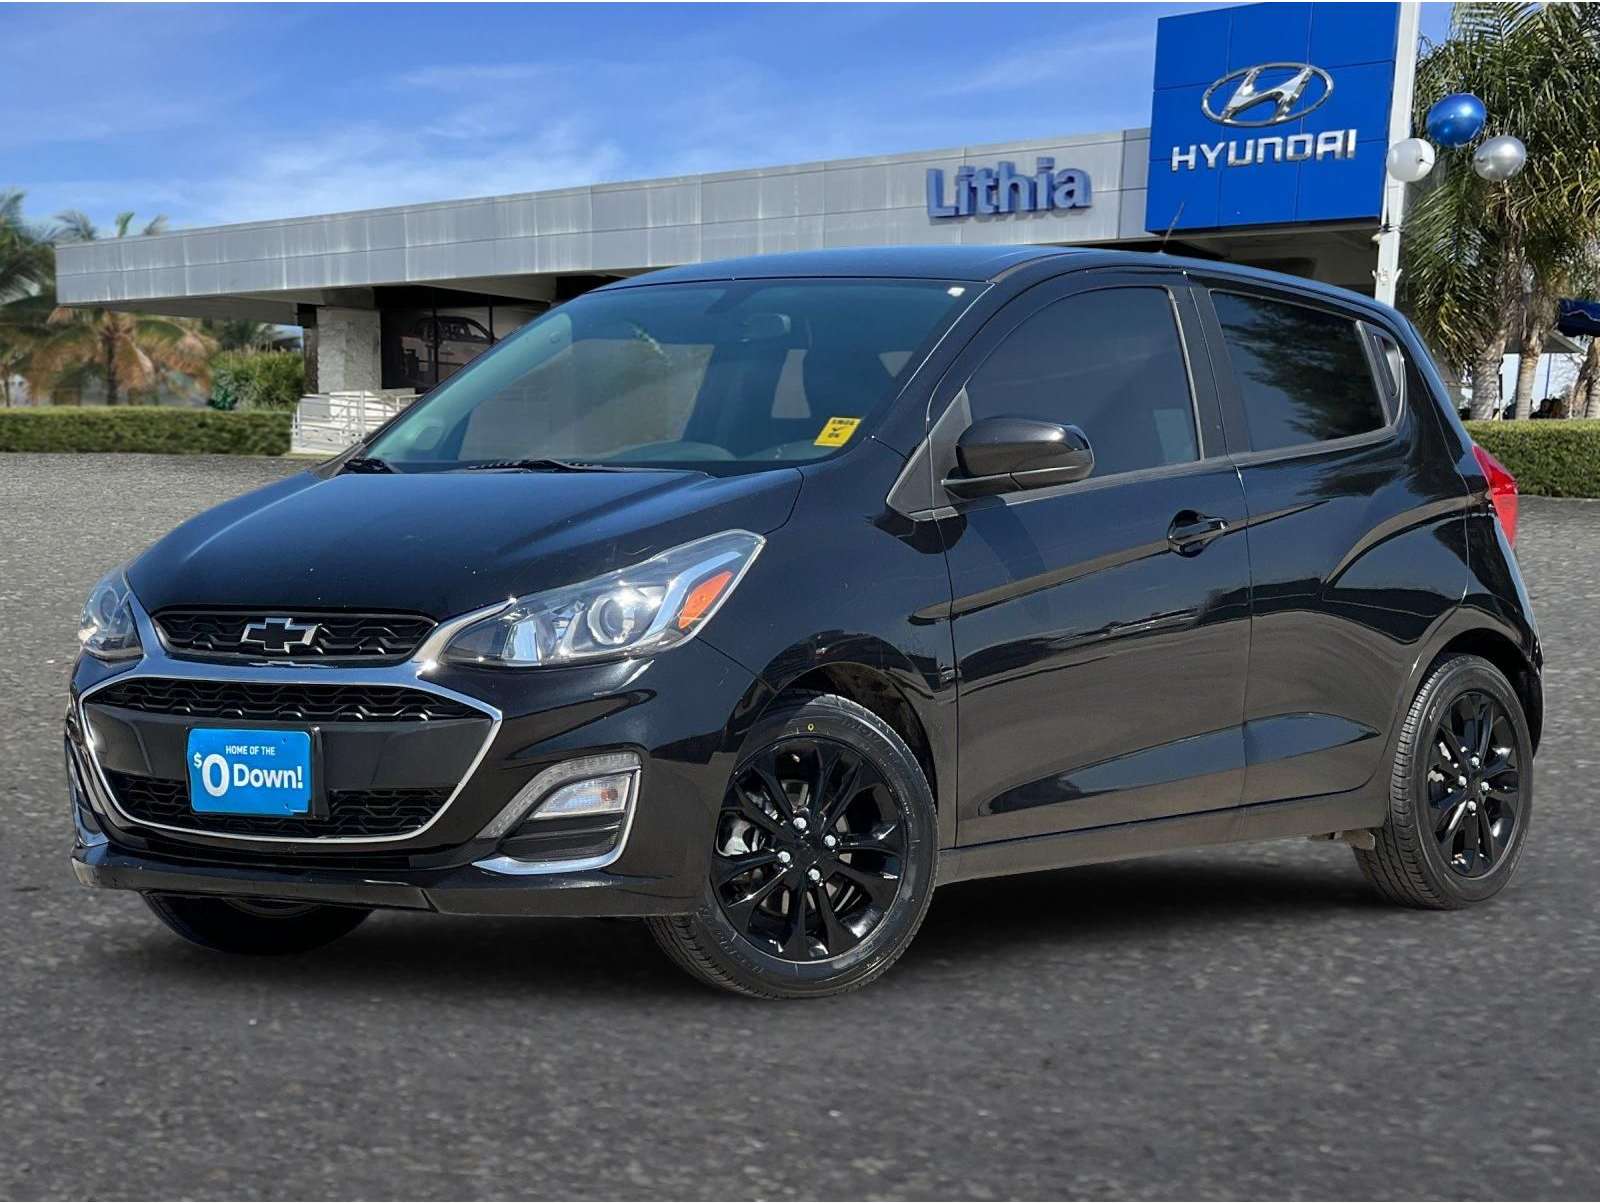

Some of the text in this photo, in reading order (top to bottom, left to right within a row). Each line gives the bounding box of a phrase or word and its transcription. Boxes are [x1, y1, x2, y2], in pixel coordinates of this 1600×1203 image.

[1171, 129, 1357, 171] HYUNDAI
[926, 157, 1092, 217] Lithia
[225, 745, 275, 756] HOME OF THE
[233, 763, 304, 789] Down!
